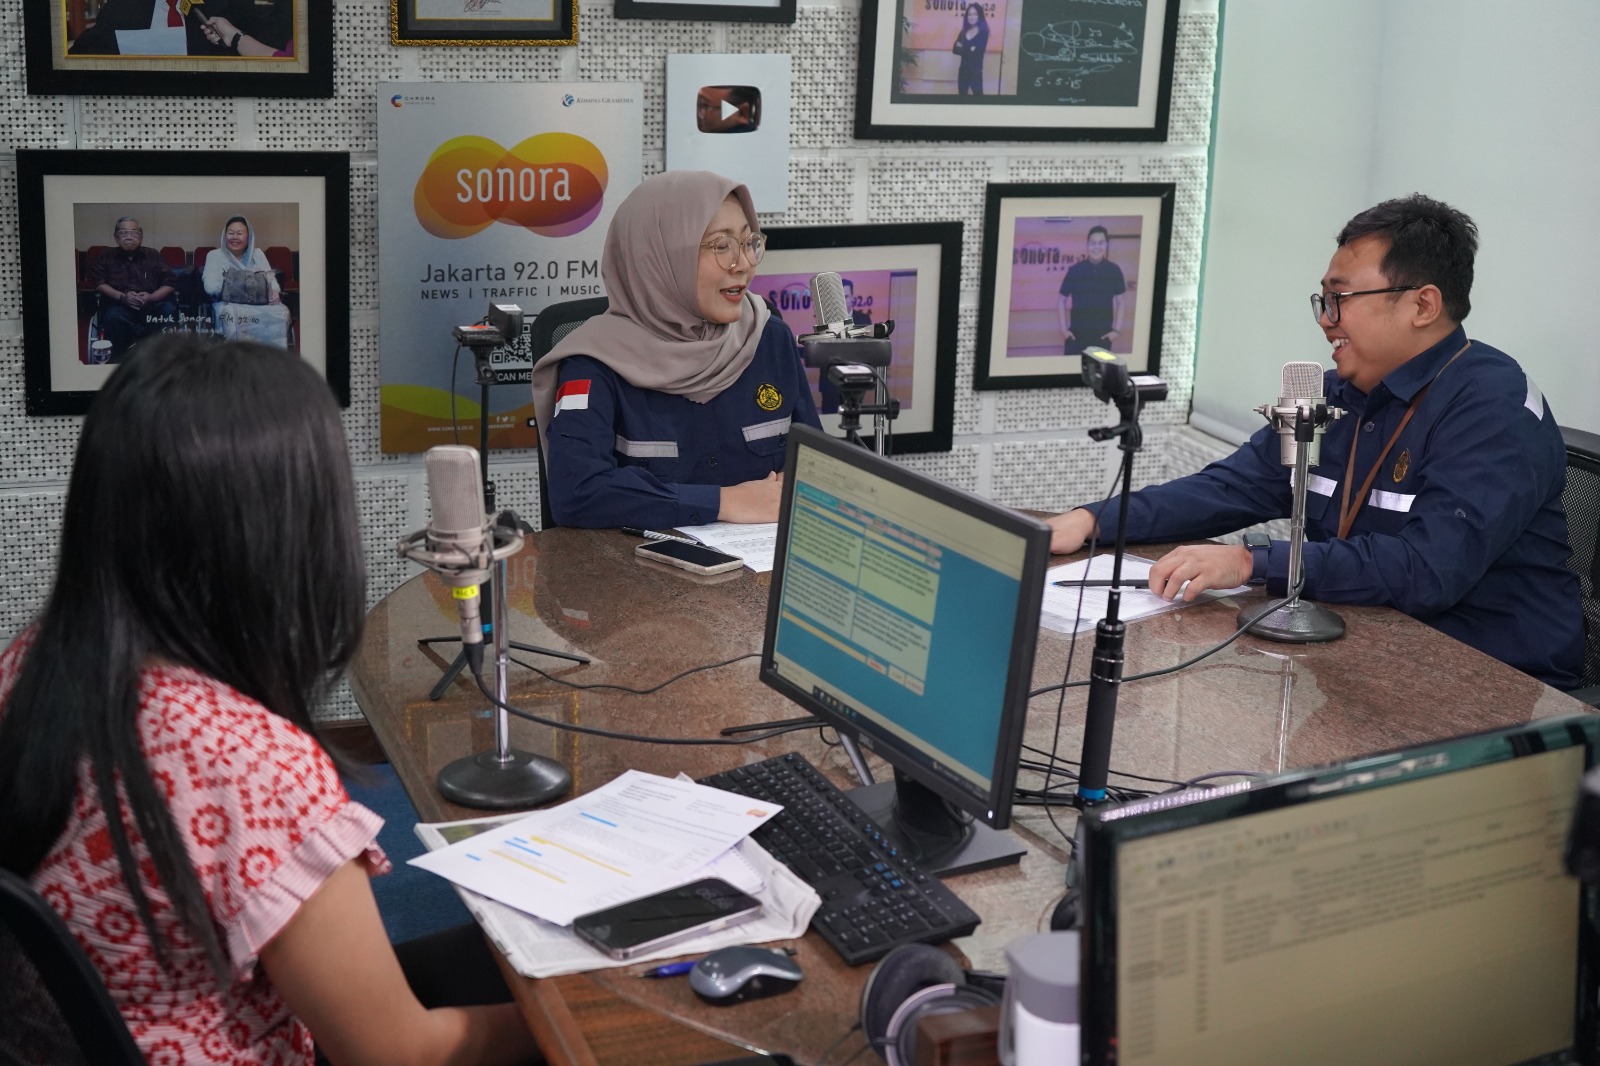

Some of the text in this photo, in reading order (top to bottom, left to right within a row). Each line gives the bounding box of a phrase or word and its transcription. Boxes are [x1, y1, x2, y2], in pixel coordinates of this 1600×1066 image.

[456, 166, 572, 203] sonora
[420, 259, 599, 283] Jakarta 92.0 FM
[421, 285, 601, 300] NEWS TRAFFIC MUSIC
[146, 314, 175, 323] Untuk
[497, 372, 533, 382] CAN ME
